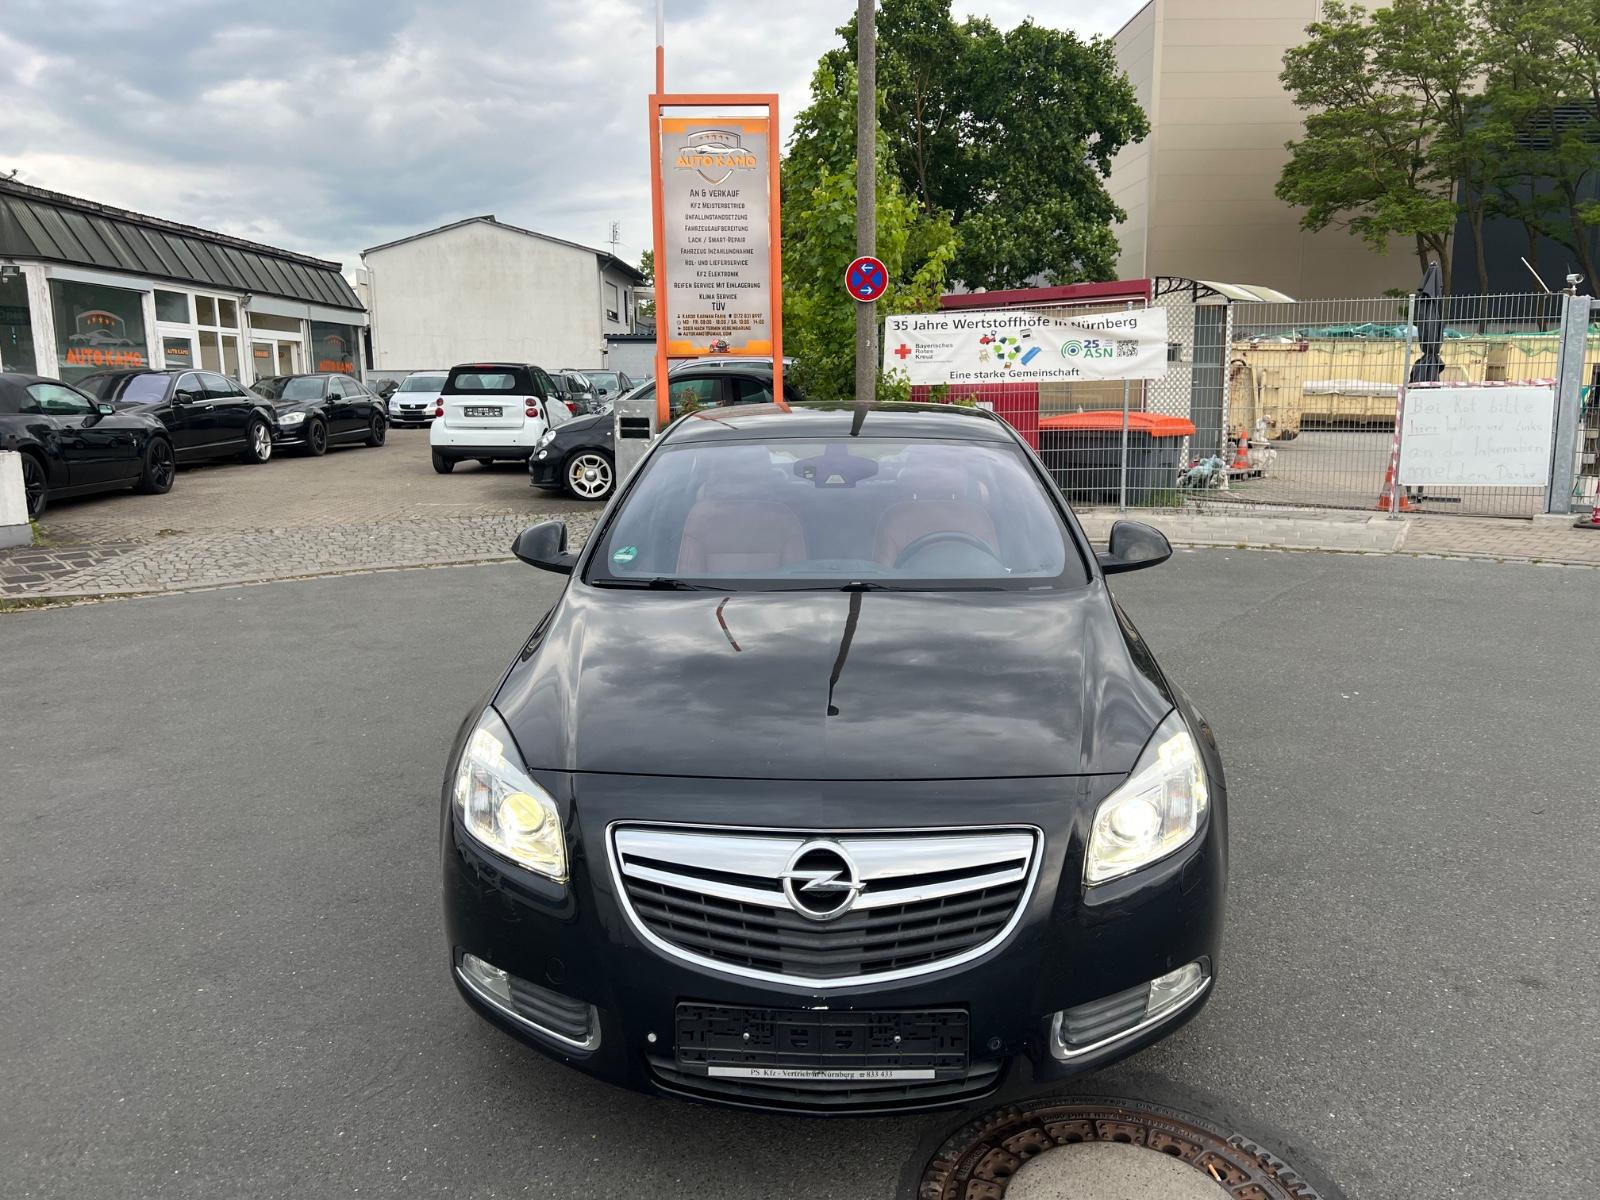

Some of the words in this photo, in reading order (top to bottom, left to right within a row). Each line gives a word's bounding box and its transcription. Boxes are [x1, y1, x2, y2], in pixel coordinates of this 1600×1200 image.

[677, 155, 714, 168] AUTO
[716, 155, 757, 168] KAMO
[690, 189, 699, 197] AN
[701, 189, 706, 197] &
[893, 320, 909, 331] 35
[913, 319, 949, 331] Jahre
[952, 316, 1050, 330] Wertstoffhöfe
[1071, 317, 1138, 331] Nürnberg
[1083, 340, 1100, 348] 25
[67, 347, 102, 367] AUTO
[105, 350, 142, 367] KAMO
[1083, 348, 1113, 358] ASN
[950, 371, 971, 379] Eine
[974, 370, 1005, 379] starke
[1008, 368, 1080, 378] Gemeinschaft
